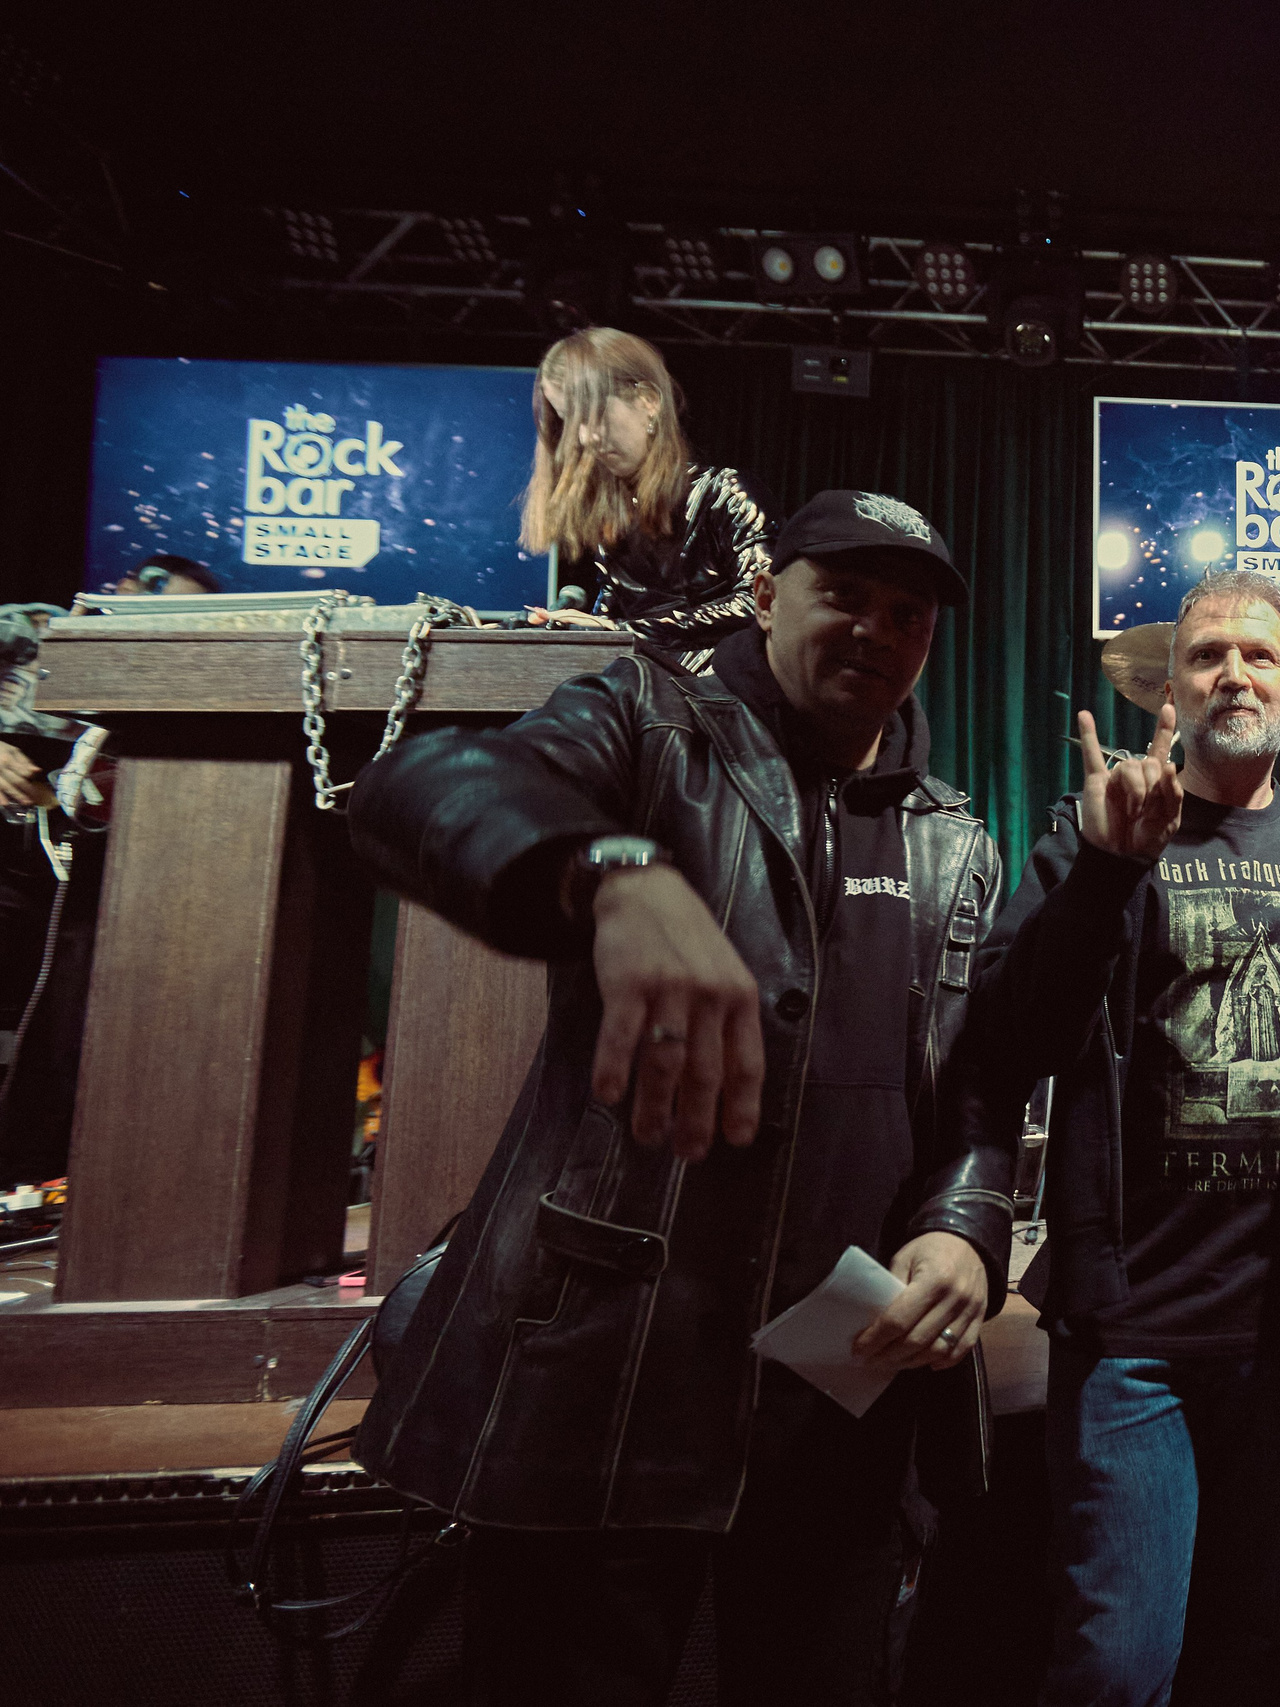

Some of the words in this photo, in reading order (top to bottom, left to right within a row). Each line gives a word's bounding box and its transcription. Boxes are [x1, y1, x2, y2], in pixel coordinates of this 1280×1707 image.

[282, 402, 337, 434] the
[247, 417, 405, 478] Rock
[244, 475, 356, 516] bar
[255, 523, 352, 540] SMALL
[255, 543, 352, 560] STAGE
[1158, 857, 1209, 884] dark
